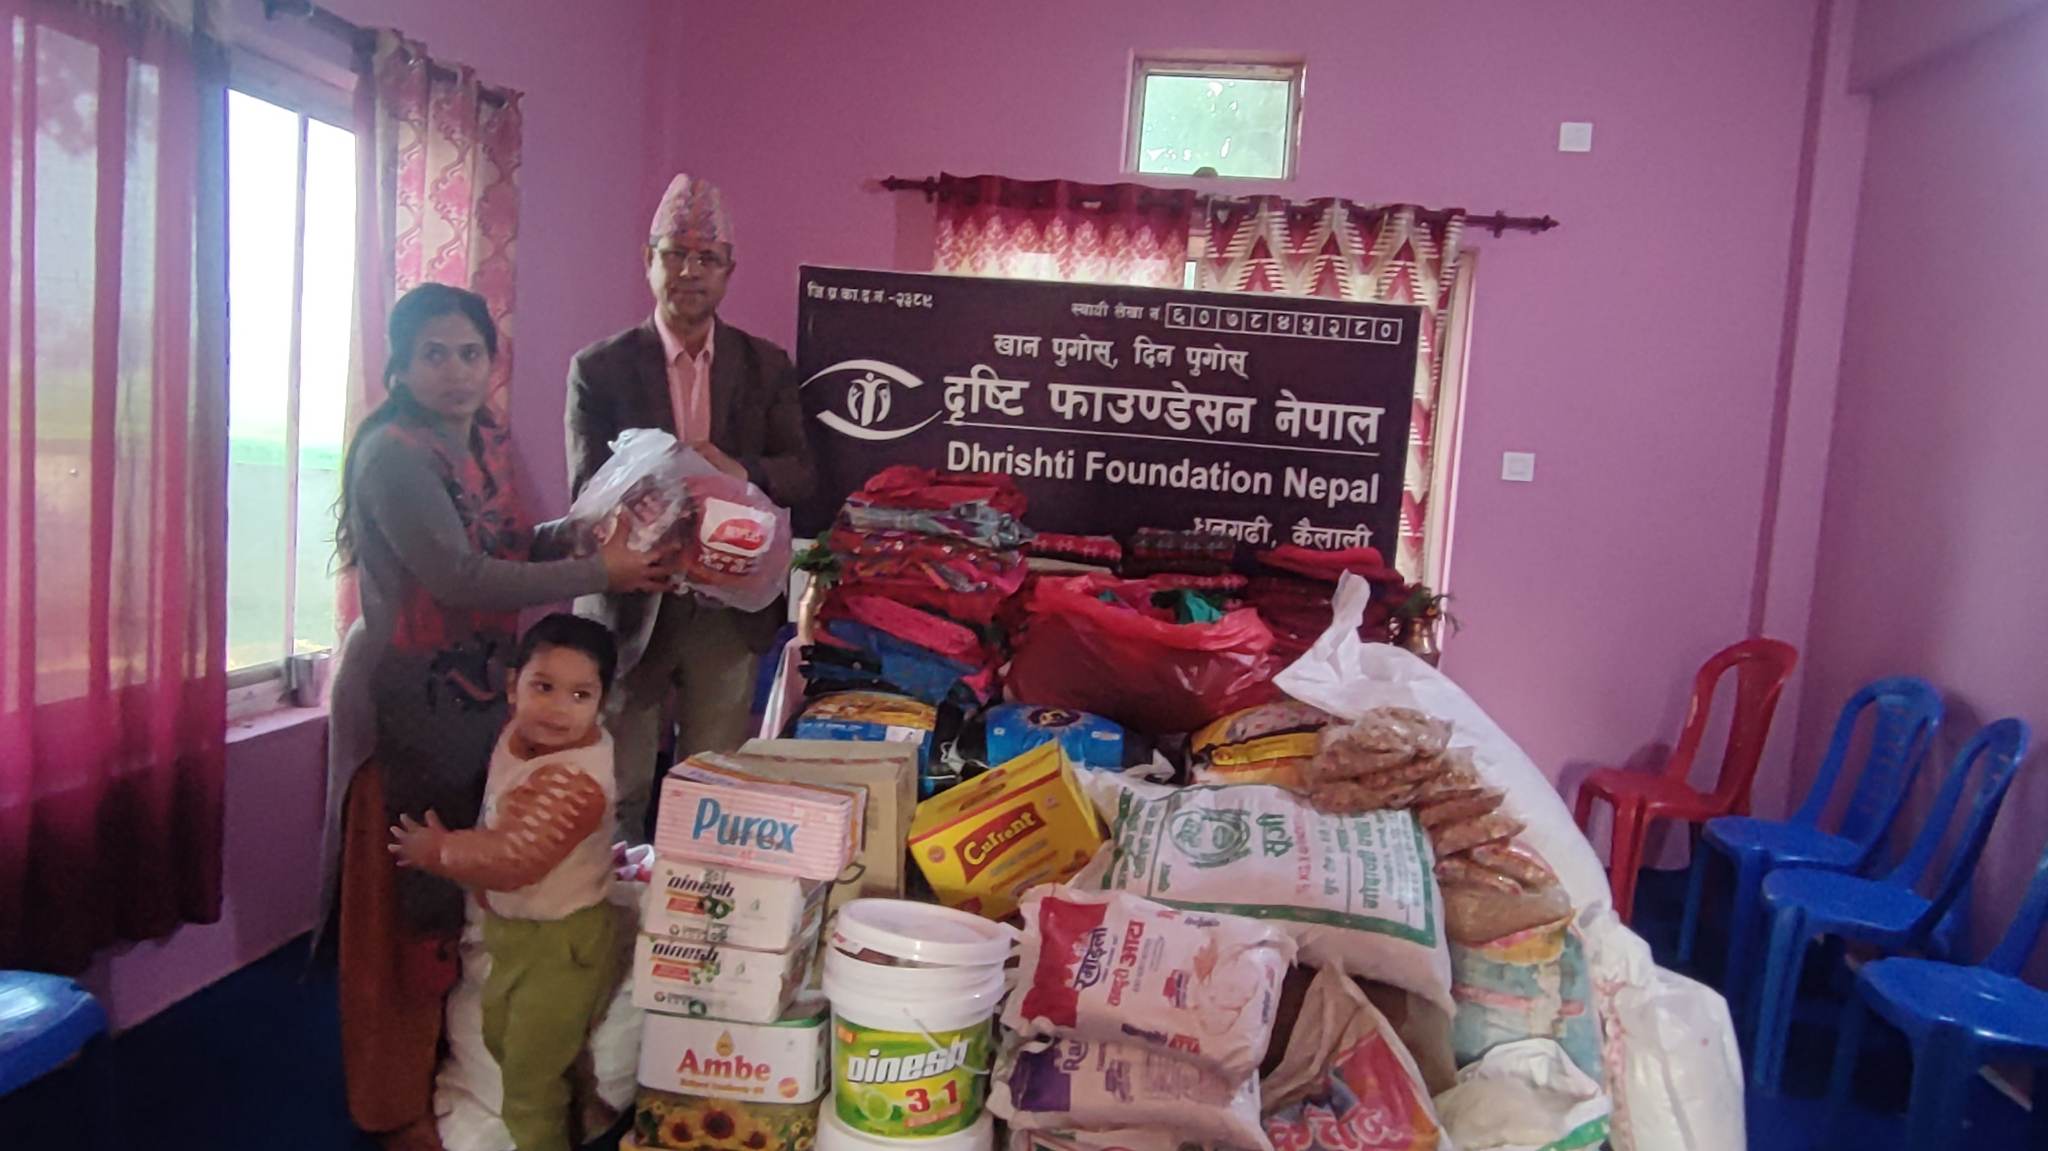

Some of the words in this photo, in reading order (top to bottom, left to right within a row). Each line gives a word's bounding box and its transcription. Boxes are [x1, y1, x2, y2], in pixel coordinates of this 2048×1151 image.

[993, 334, 1042, 358] खान
[1052, 333, 1118, 369] पुगोस्,
[1133, 335, 1175, 368] दिन
[1185, 343, 1249, 379] पुगोस्
[944, 364, 1030, 426] दृष्टि
[1048, 381, 1257, 434] फाउण्डेसन
[1275, 389, 1385, 445] नेपाल
[947, 441, 1075, 480] Dhrishti
[1085, 451, 1272, 496] Foundation
[1283, 466, 1379, 508] Nepal
[1292, 517, 1373, 549] कैलाली
[692, 797, 799, 853] Purex
[963, 811, 1036, 866] Current
[1120, 919, 1146, 968] आटा
[676, 1048, 772, 1082] Ambe
